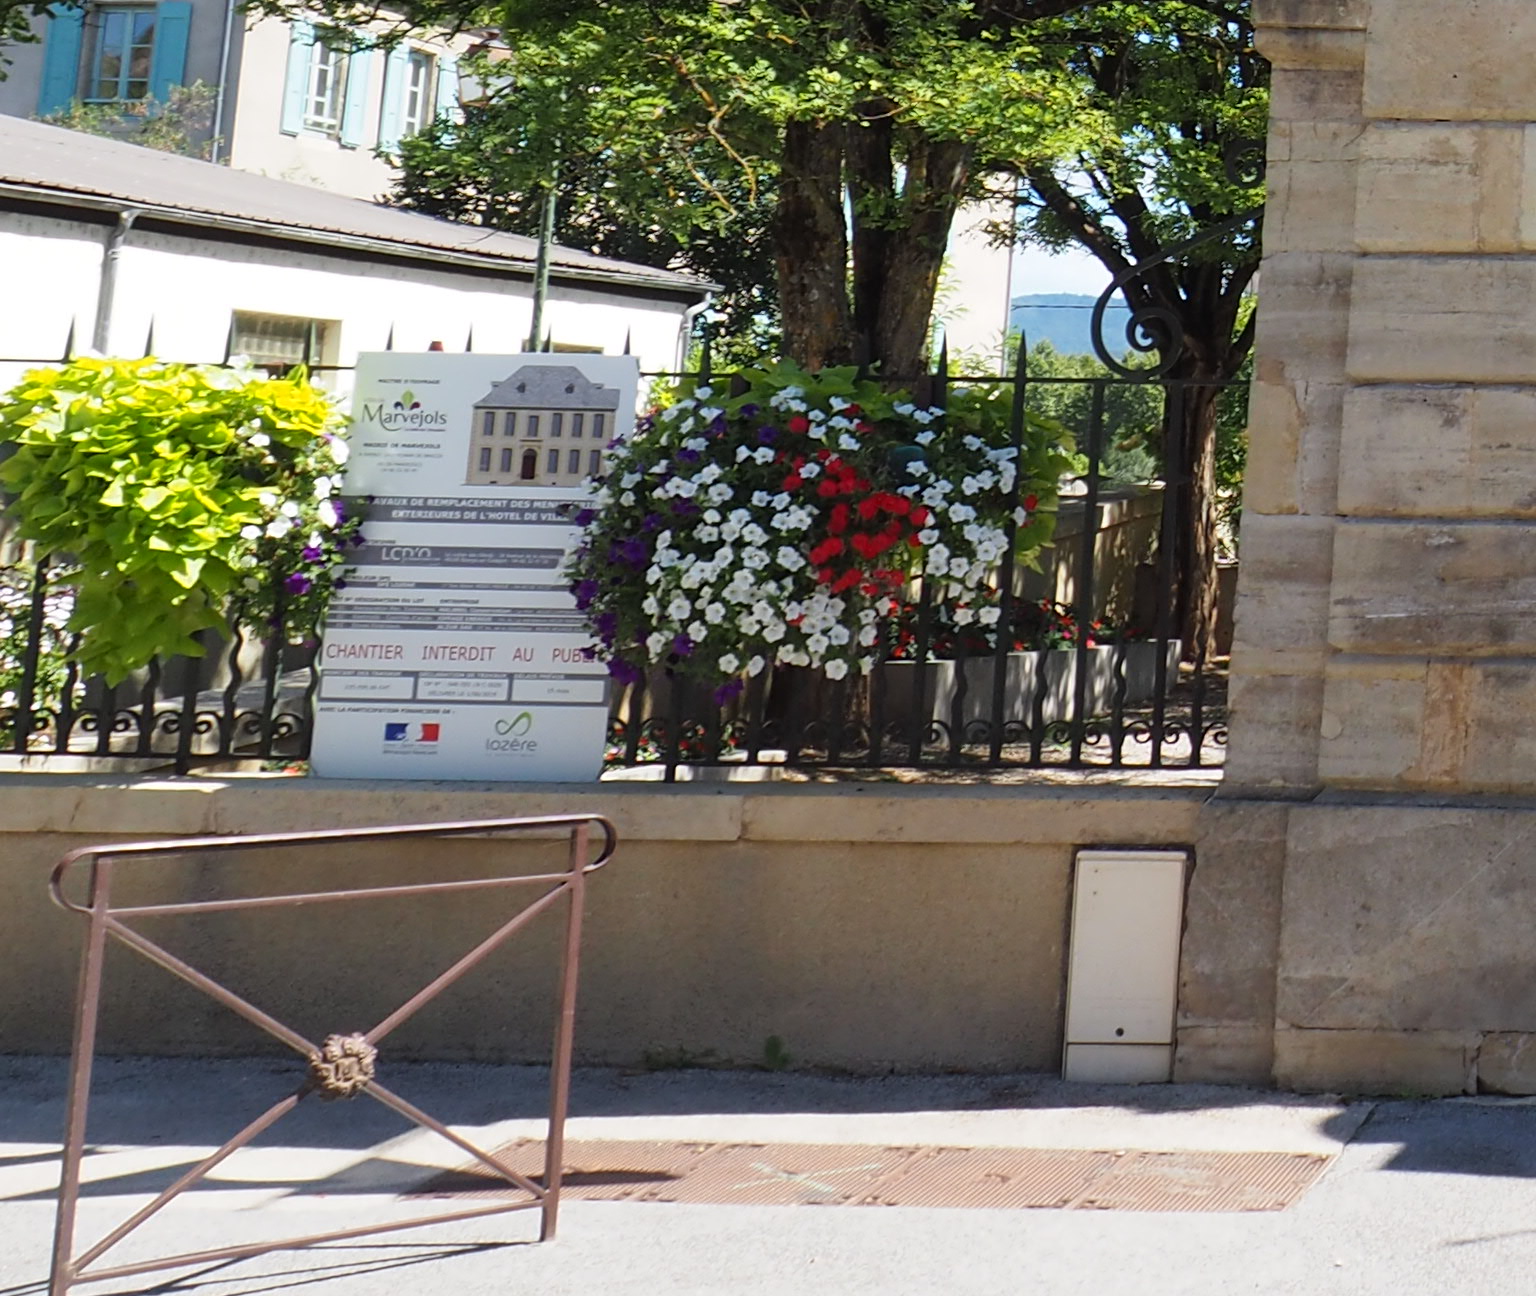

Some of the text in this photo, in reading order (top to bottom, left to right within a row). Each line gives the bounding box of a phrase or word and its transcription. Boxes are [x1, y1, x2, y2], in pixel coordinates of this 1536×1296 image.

[361, 403, 447, 432] Marvejols
[411, 498, 424, 507] DE
[427, 498, 507, 508] REMPLACEMENT
[510, 500, 530, 509] DES
[463, 511, 477, 520] DE
[524, 512, 538, 521] DE
[326, 644, 403, 660] CHANTIER
[422, 645, 496, 661] INTERDIT
[512, 648, 534, 662] AU
